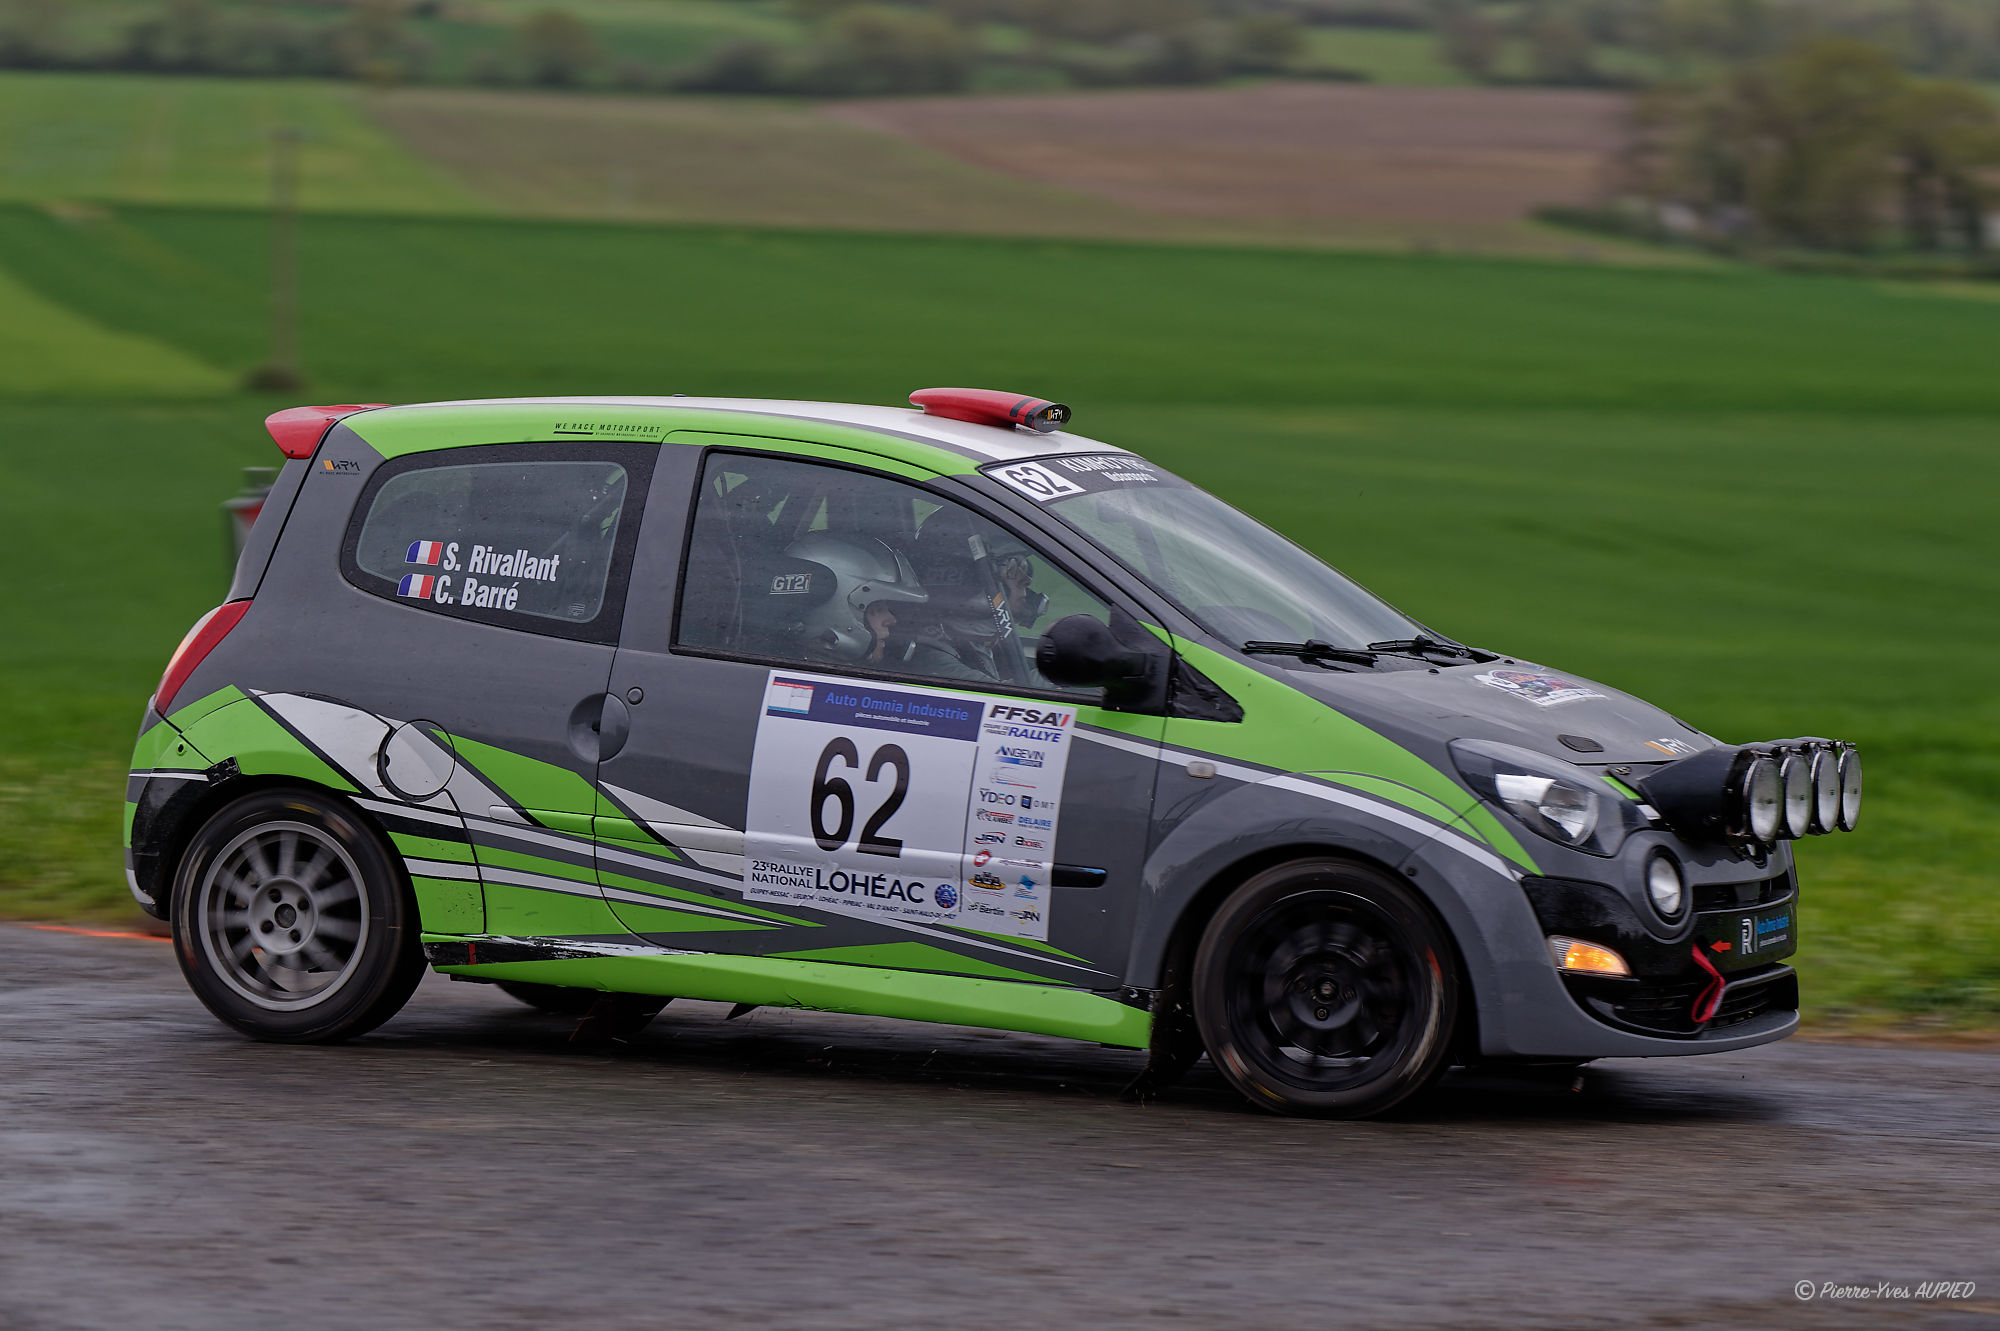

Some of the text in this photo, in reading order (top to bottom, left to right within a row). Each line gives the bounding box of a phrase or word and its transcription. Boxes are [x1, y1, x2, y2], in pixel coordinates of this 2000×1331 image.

[555, 422, 568, 430] WE
[572, 423, 595, 431] RACE
[1005, 466, 1073, 496] 62
[442, 541, 560, 582] S. Rivallant
[434, 574, 520, 611] C. Barré
[772, 573, 811, 592] GT2i
[825, 691, 969, 721] Auto Omnia Industrie
[989, 704, 1058, 727] FFSA
[1007, 726, 1062, 743] RALLYE
[994, 744, 1046, 761] ANGEVIN
[809, 736, 911, 859] 62
[979, 790, 1016, 806] YDEO
[1018, 815, 1053, 828] DELAIRE
[751, 872, 813, 889] NATIONAL
[815, 868, 925, 904] LOHÉAC
